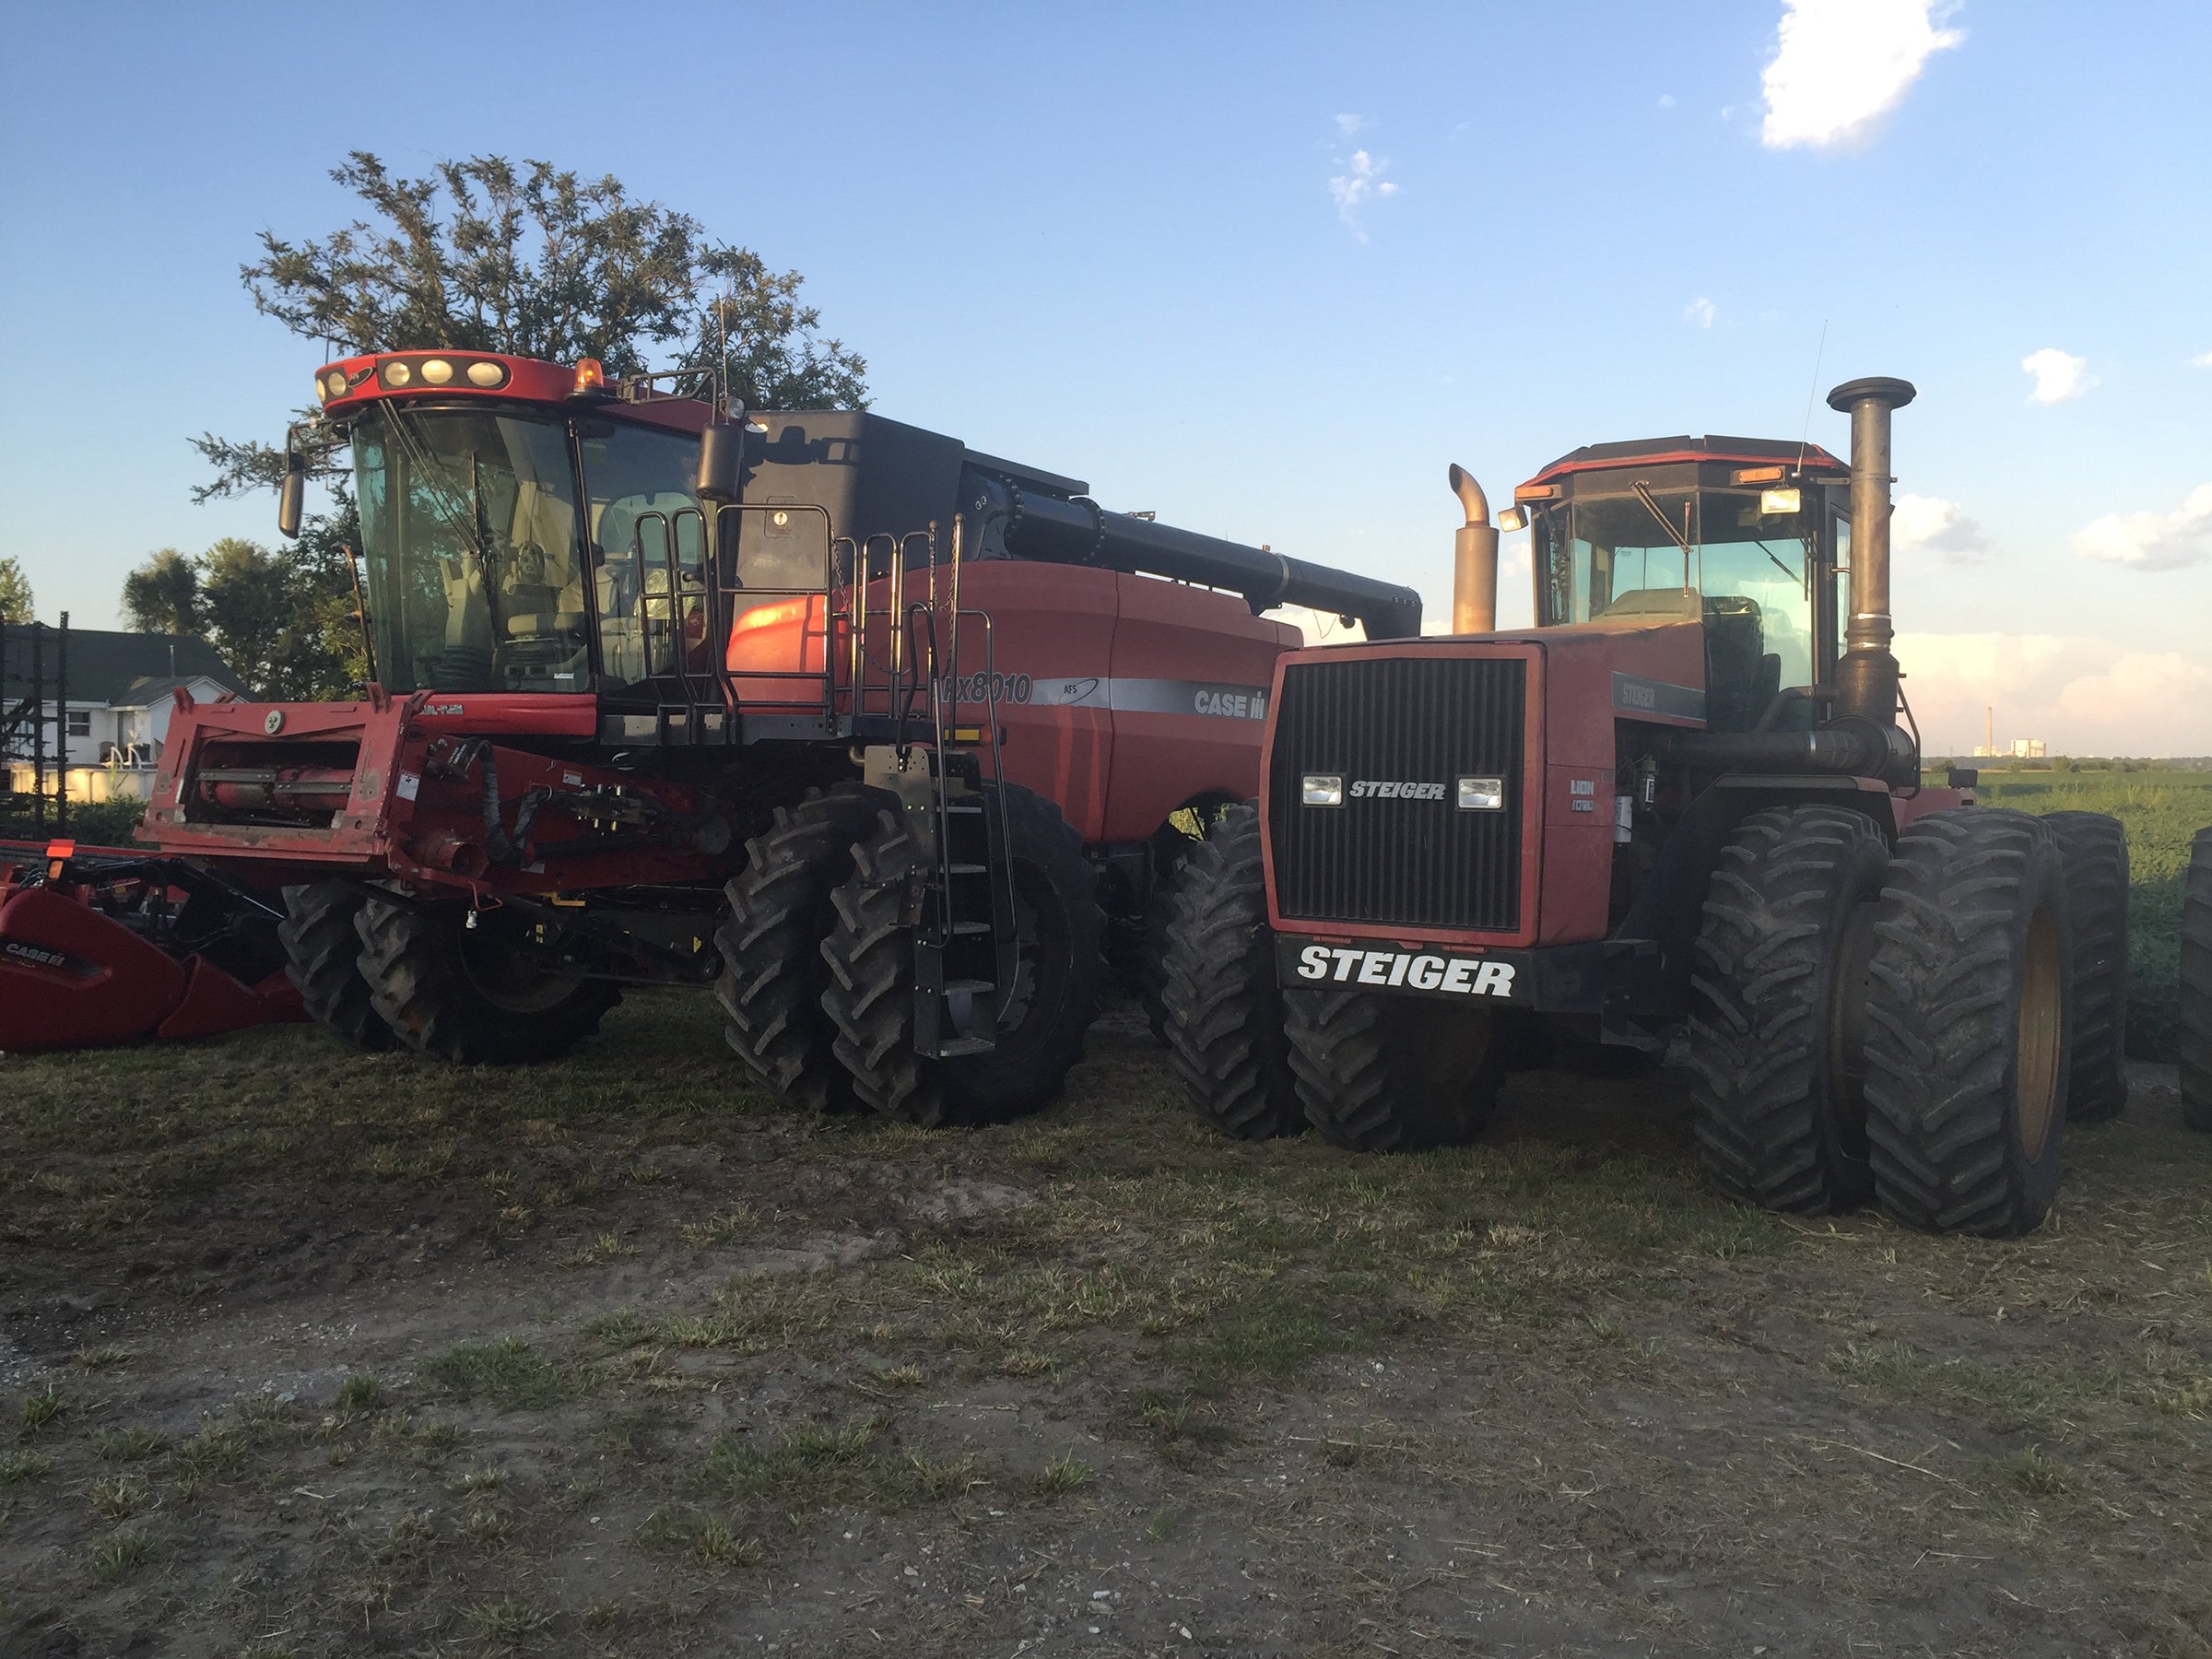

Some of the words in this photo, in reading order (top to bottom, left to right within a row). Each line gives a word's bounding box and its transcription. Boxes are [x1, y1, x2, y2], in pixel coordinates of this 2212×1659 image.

[1064, 685, 1077, 694] AFS
[1194, 690, 1247, 717] CASE
[1349, 780, 1446, 800] STEIGER
[6, 943, 51, 962] CASE
[1297, 946, 1516, 997] STEIGER
